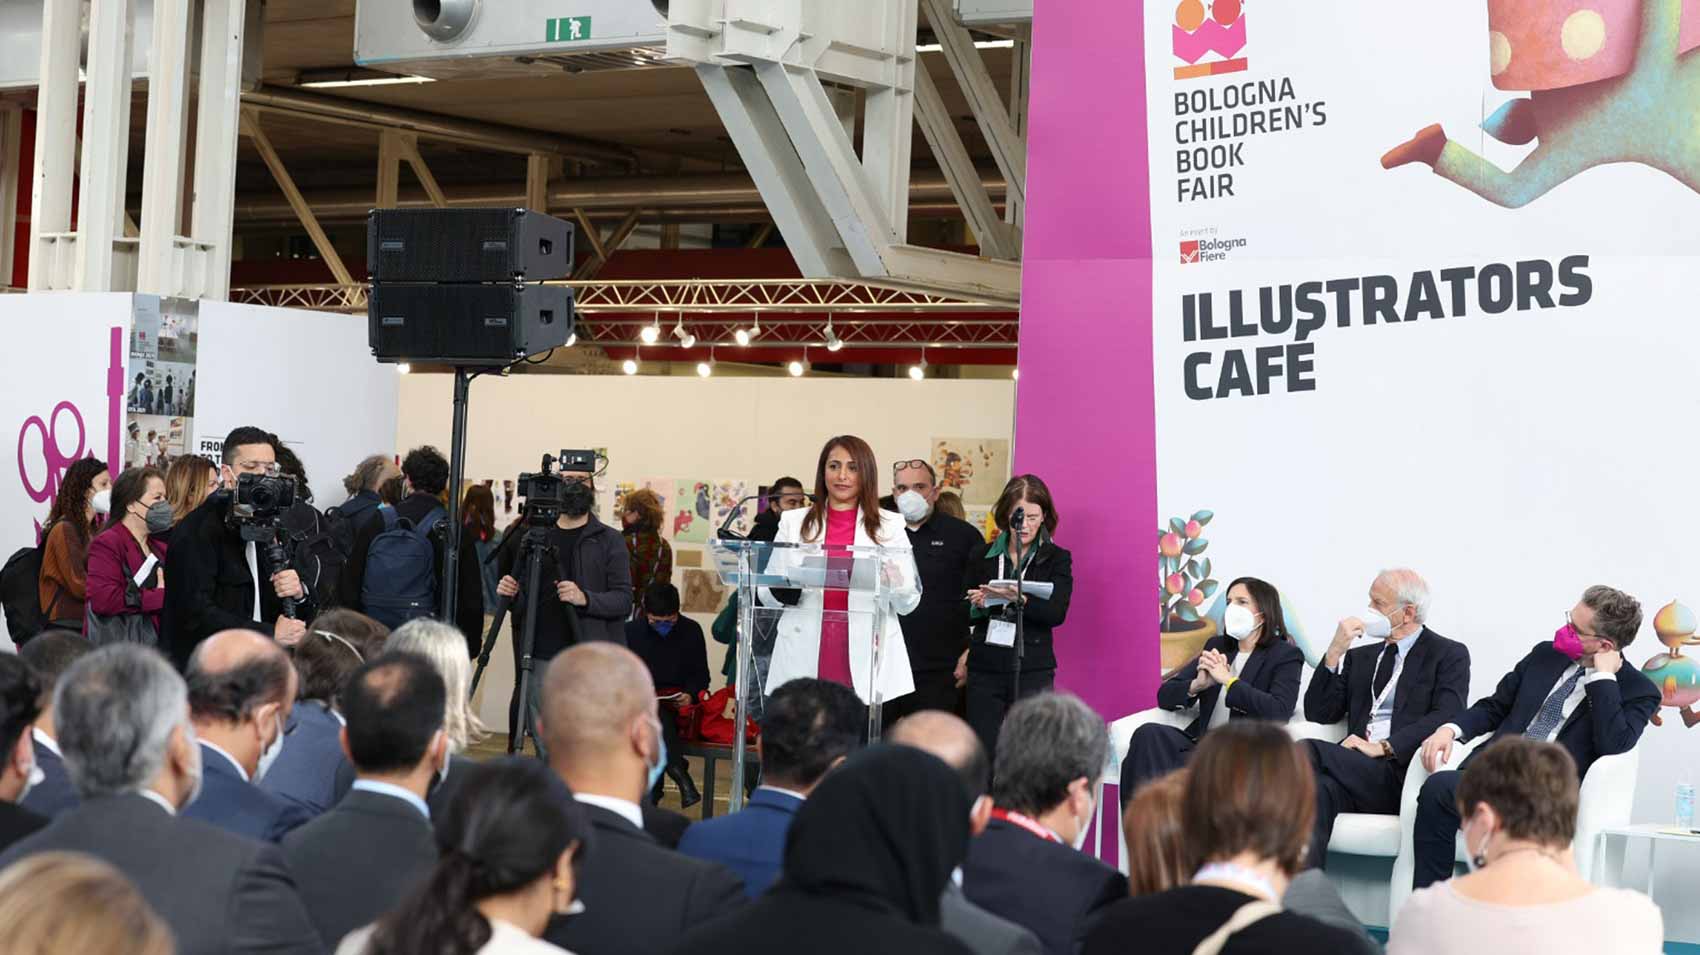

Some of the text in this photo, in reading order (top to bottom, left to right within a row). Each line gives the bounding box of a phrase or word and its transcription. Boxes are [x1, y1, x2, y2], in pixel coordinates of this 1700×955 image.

[1175, 77, 1296, 116] BOLOGNA
[1176, 102, 1327, 145] CHILDREN'S
[1177, 143, 1245, 174] BOOK
[1178, 174, 1235, 203] FAIR
[1199, 238, 1247, 251] Bologna
[1200, 251, 1226, 262] Fiere
[1182, 255, 1593, 342] ILLUSTRATORS
[1184, 319, 1316, 401] CAFÉ
